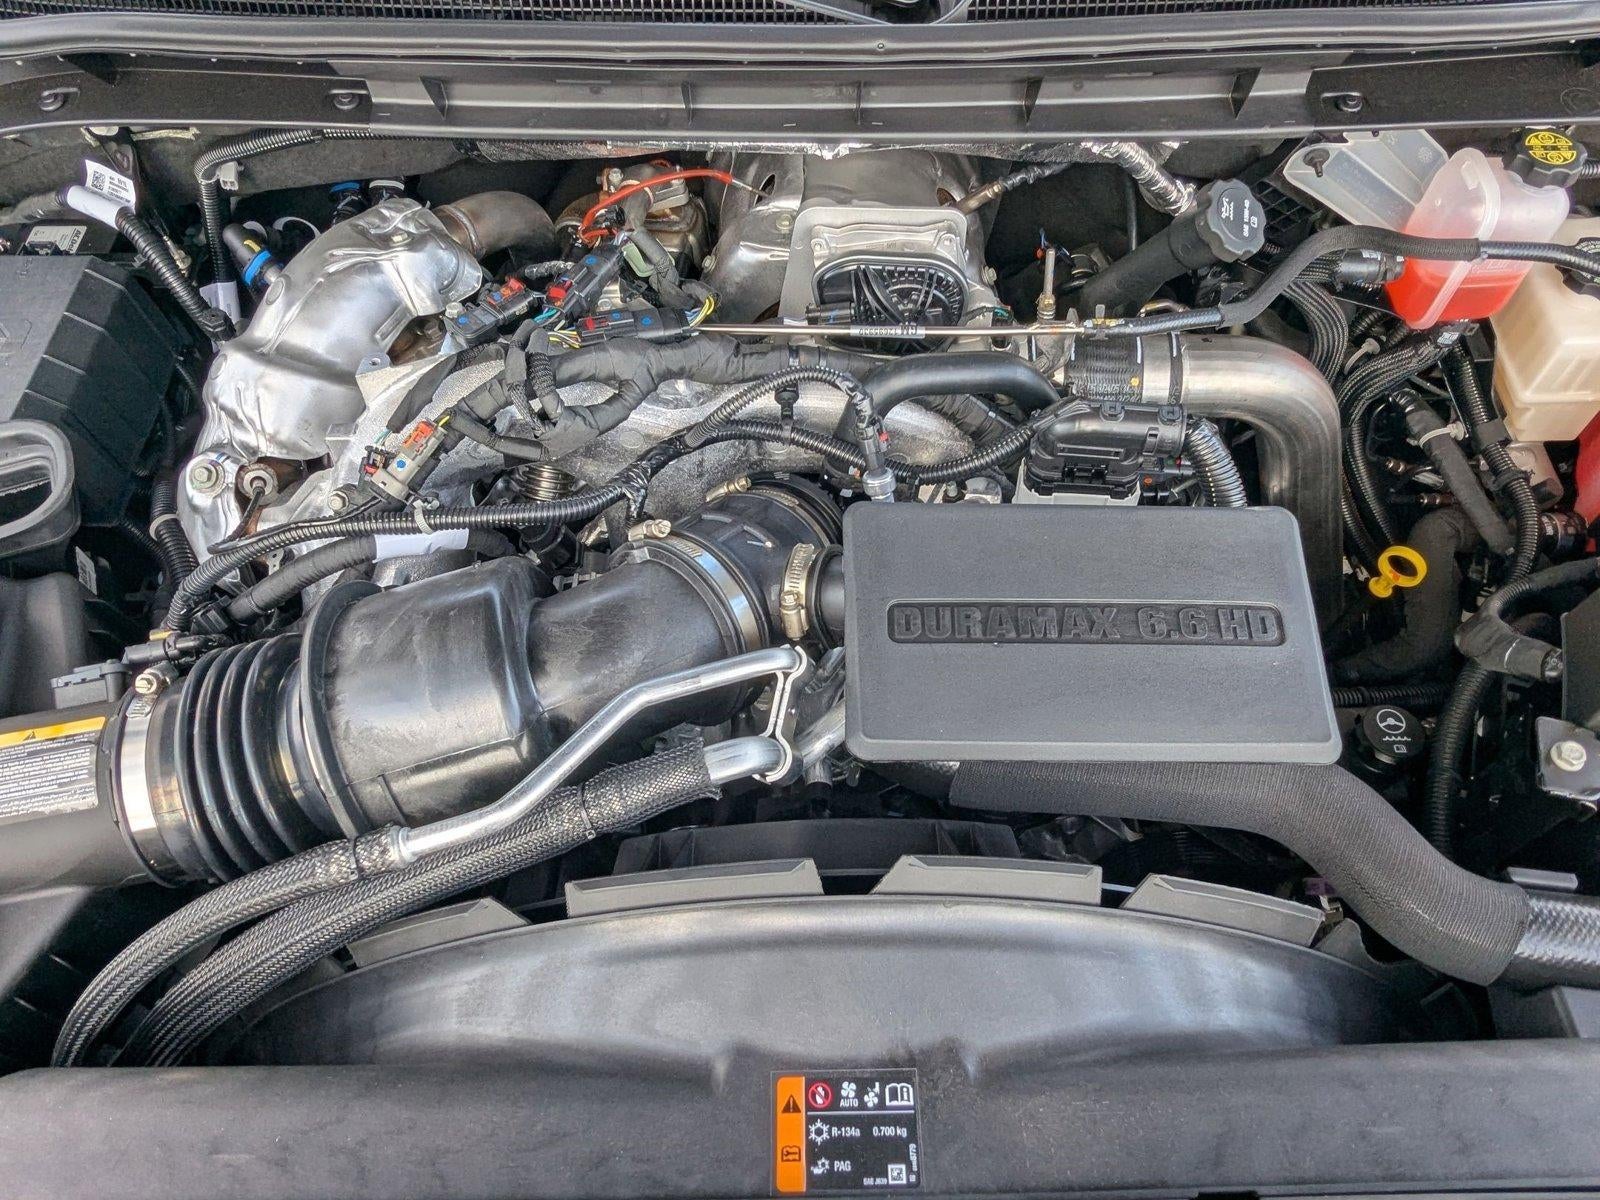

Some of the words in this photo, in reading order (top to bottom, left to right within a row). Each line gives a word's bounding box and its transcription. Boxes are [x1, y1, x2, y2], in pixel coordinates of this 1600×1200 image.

[893, 605, 1121, 640] DURAMAX
[1136, 606, 1208, 641] 6.6
[1215, 608, 1280, 642] HD
[839, 1098, 859, 1108] AUTO
[831, 1126, 861, 1137] R-134a
[872, 1126, 895, 1136] 0.700
[896, 1126, 908, 1138] kg
[834, 1160, 852, 1172] PAG
